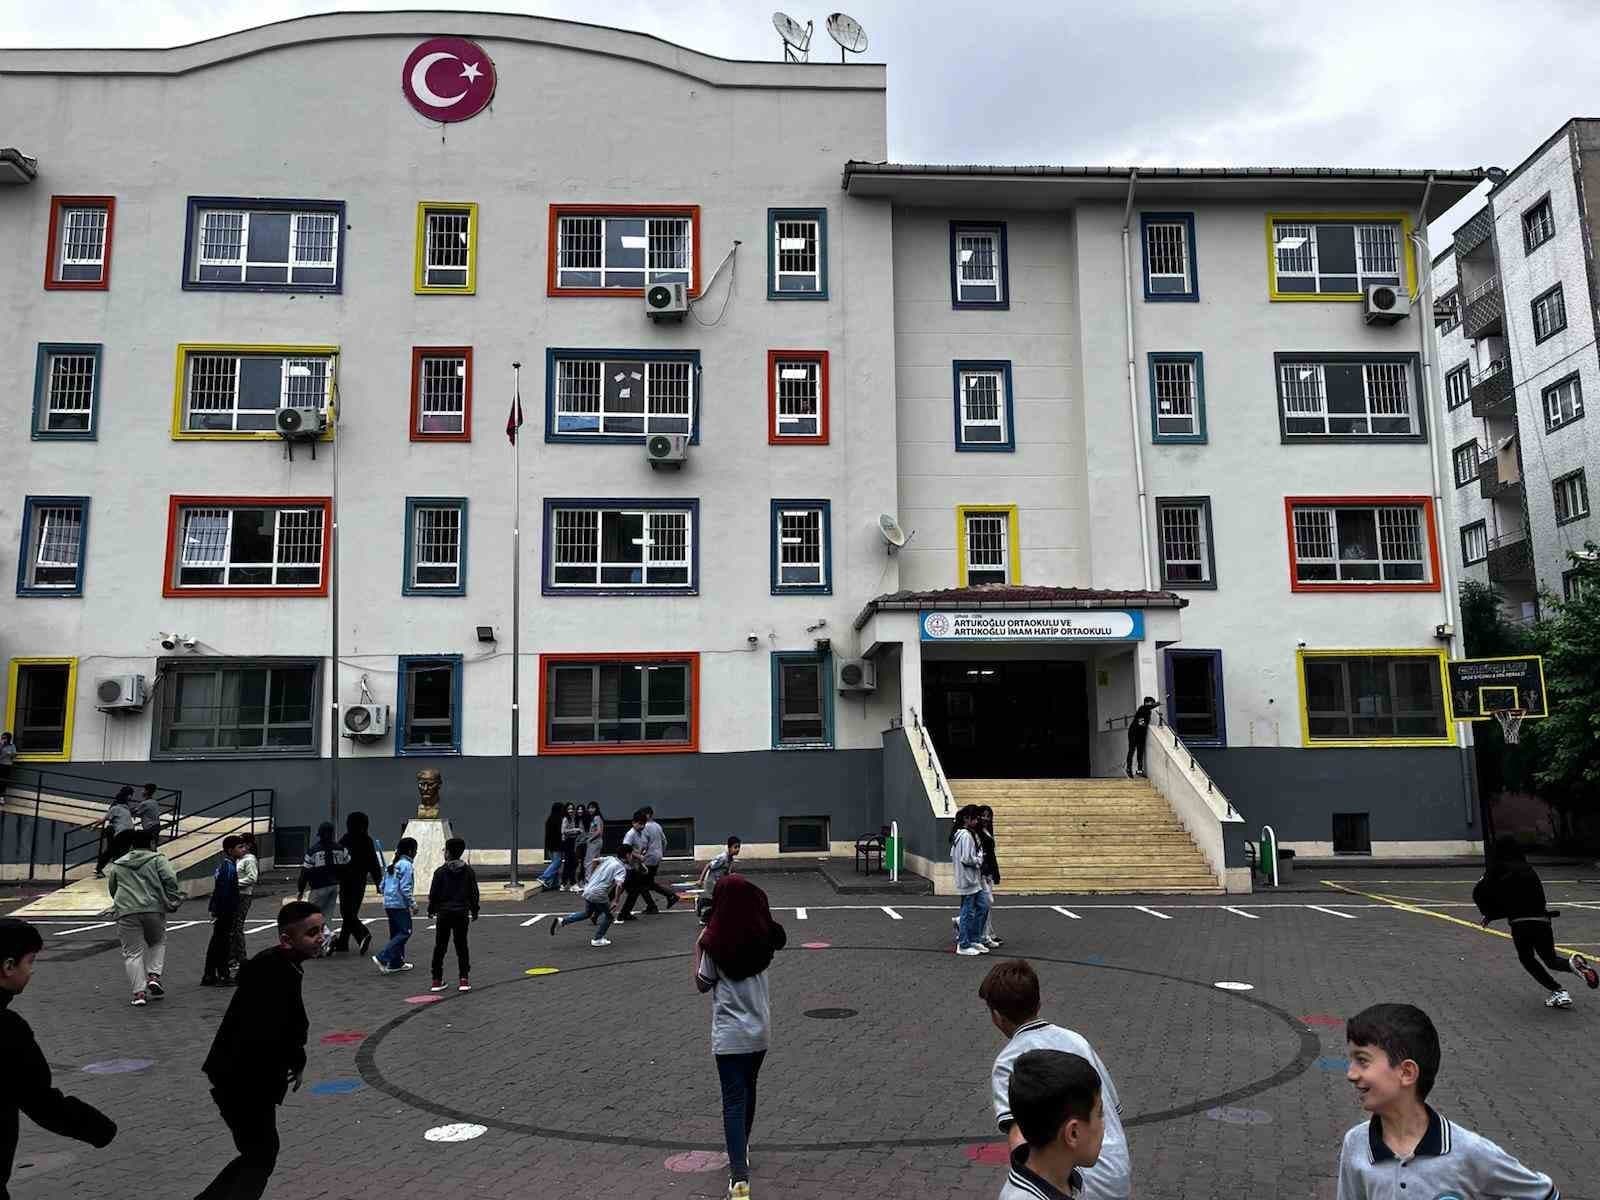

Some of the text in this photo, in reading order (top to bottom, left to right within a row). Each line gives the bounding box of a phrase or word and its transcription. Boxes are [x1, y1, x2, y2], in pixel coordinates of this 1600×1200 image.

[954, 618, 1072, 627] ARTUKOĞLU ORTAOKULU VE
[954, 626, 1112, 635] ARTUKOĞLU İMAM HATİP ORTAOKULU
